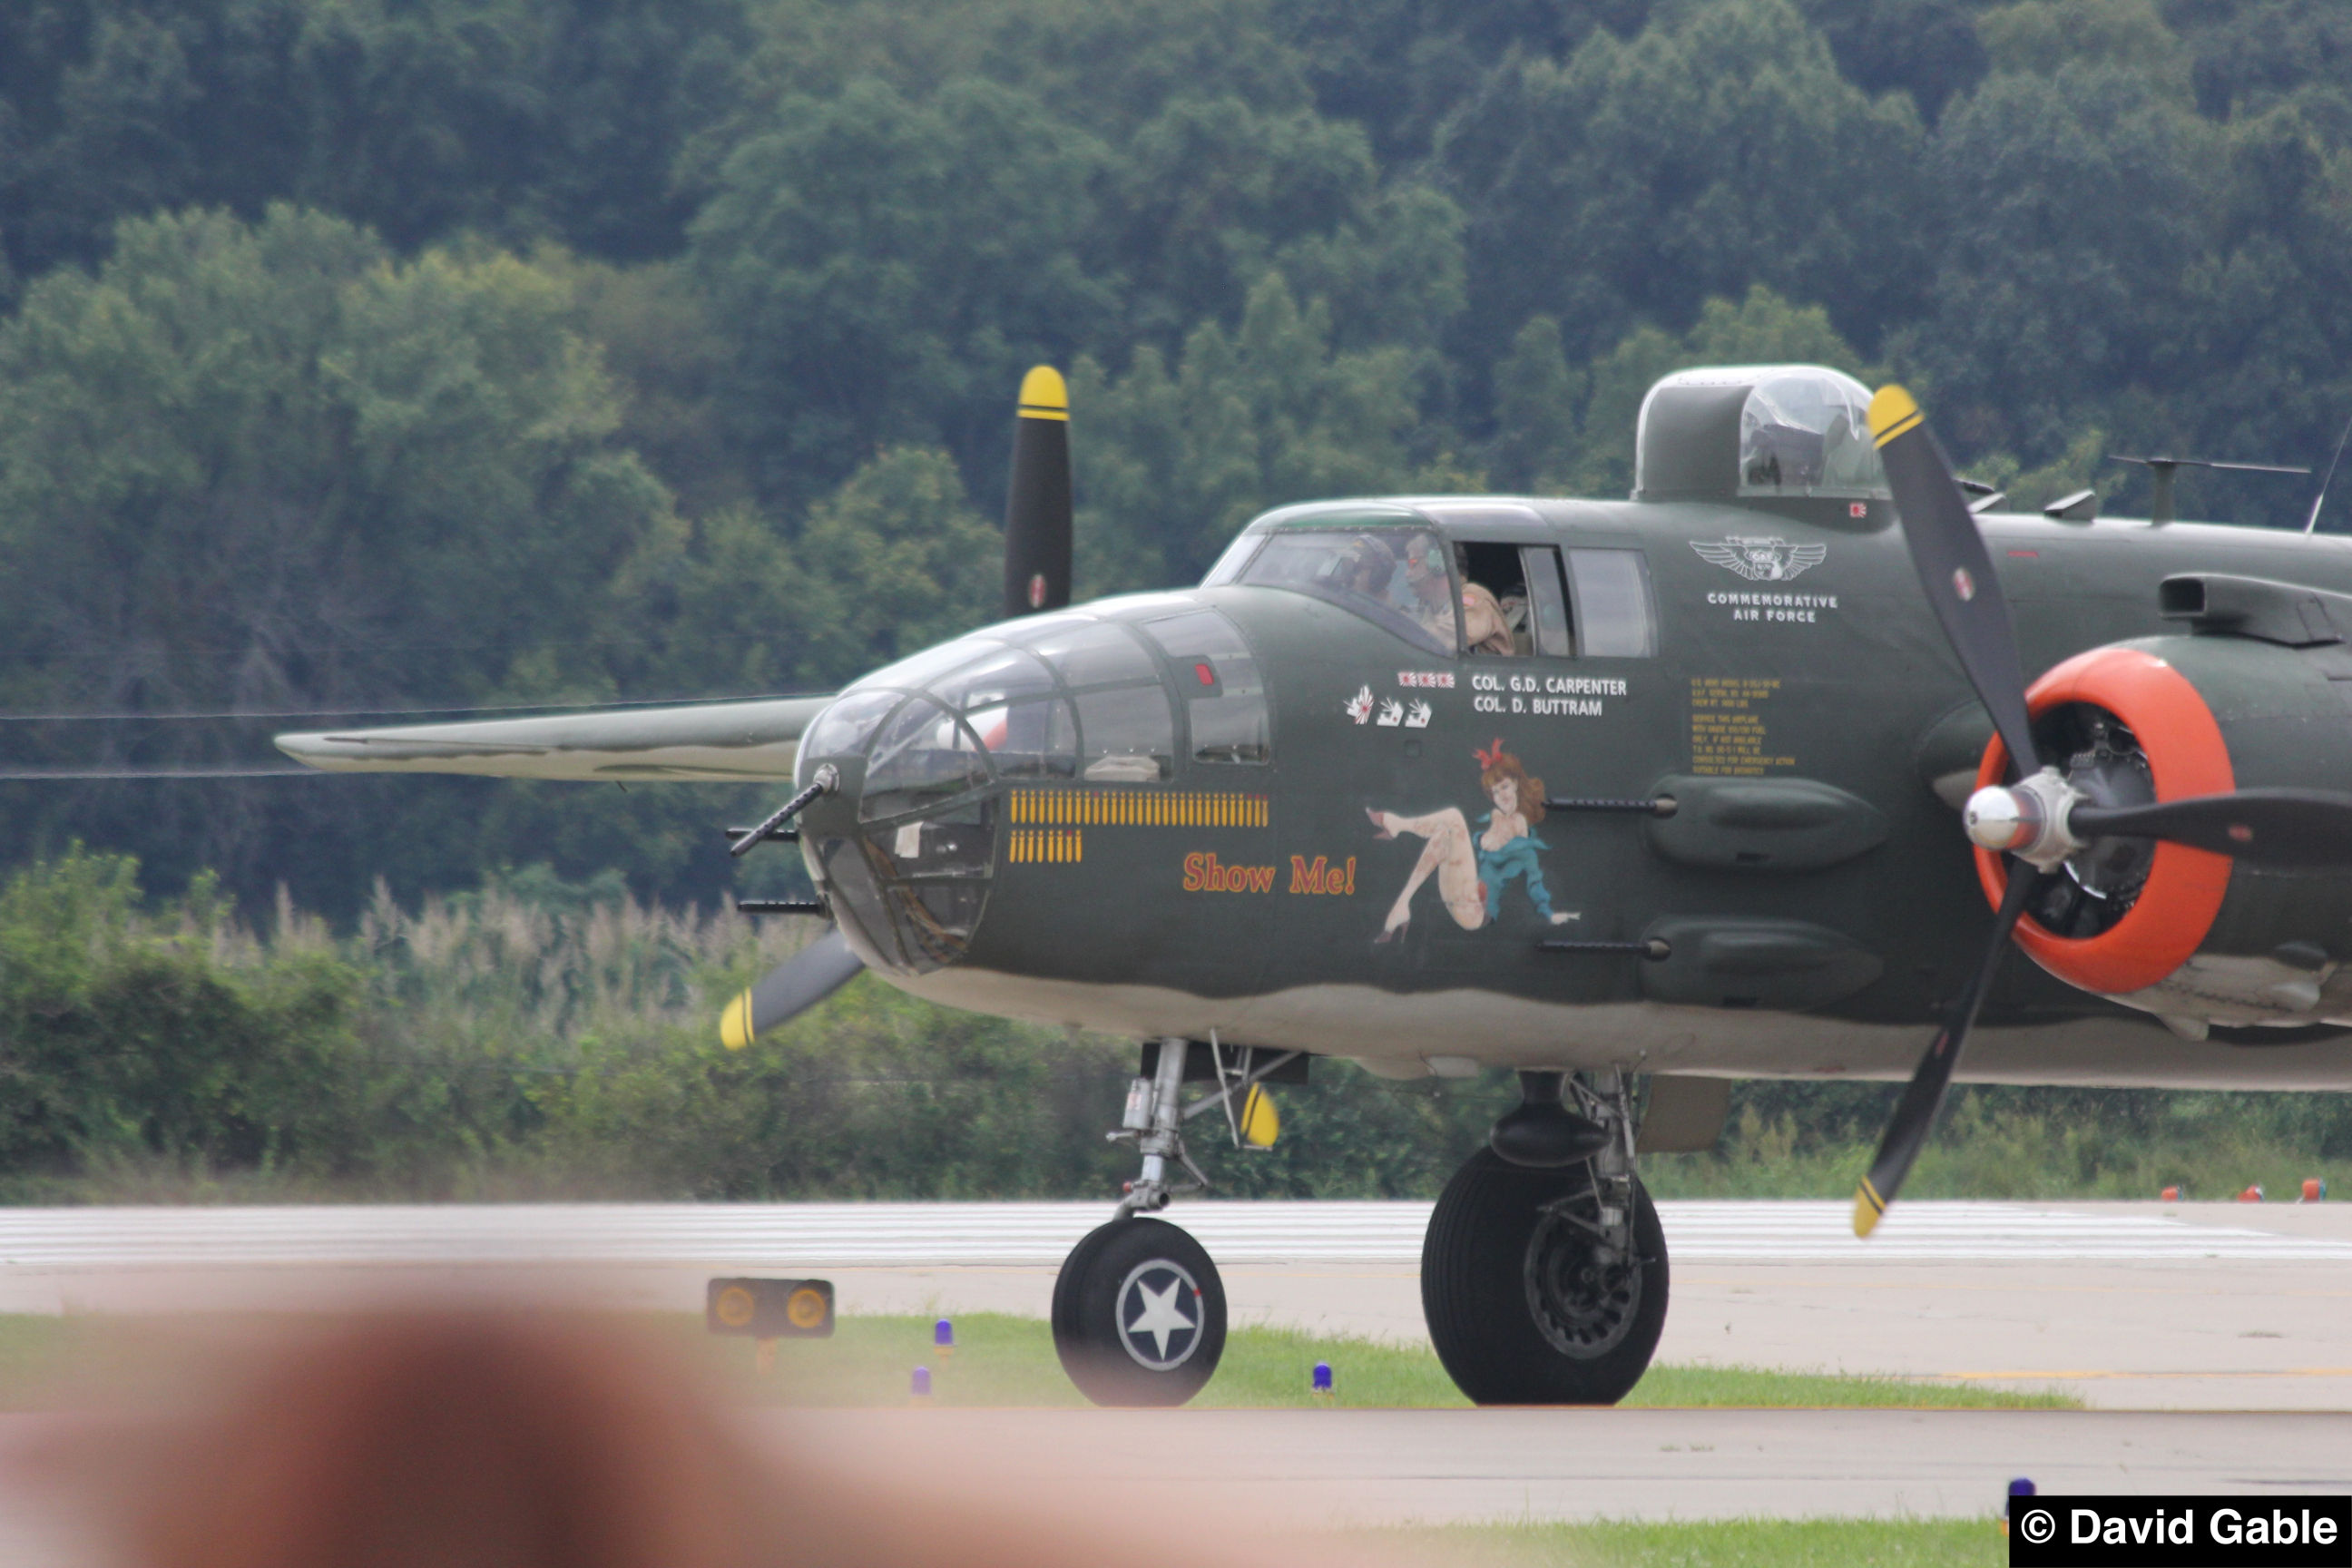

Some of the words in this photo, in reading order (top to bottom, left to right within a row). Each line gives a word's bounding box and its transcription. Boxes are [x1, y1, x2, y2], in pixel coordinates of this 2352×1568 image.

[1707, 593, 1838, 609] COMMEMORATIVE
[1733, 609, 1759, 622] AIR
[1766, 610, 1817, 623] FORCE
[1472, 674, 1504, 692] COL.
[1510, 675, 1540, 693] G.D.
[1545, 676, 1627, 696] CARPENTER
[1474, 695, 1506, 713] COL.
[1512, 696, 1526, 714] D.
[1533, 697, 1602, 717] BUTTRAM
[1183, 851, 1276, 894] Show
[1289, 854, 1357, 896] Me!
